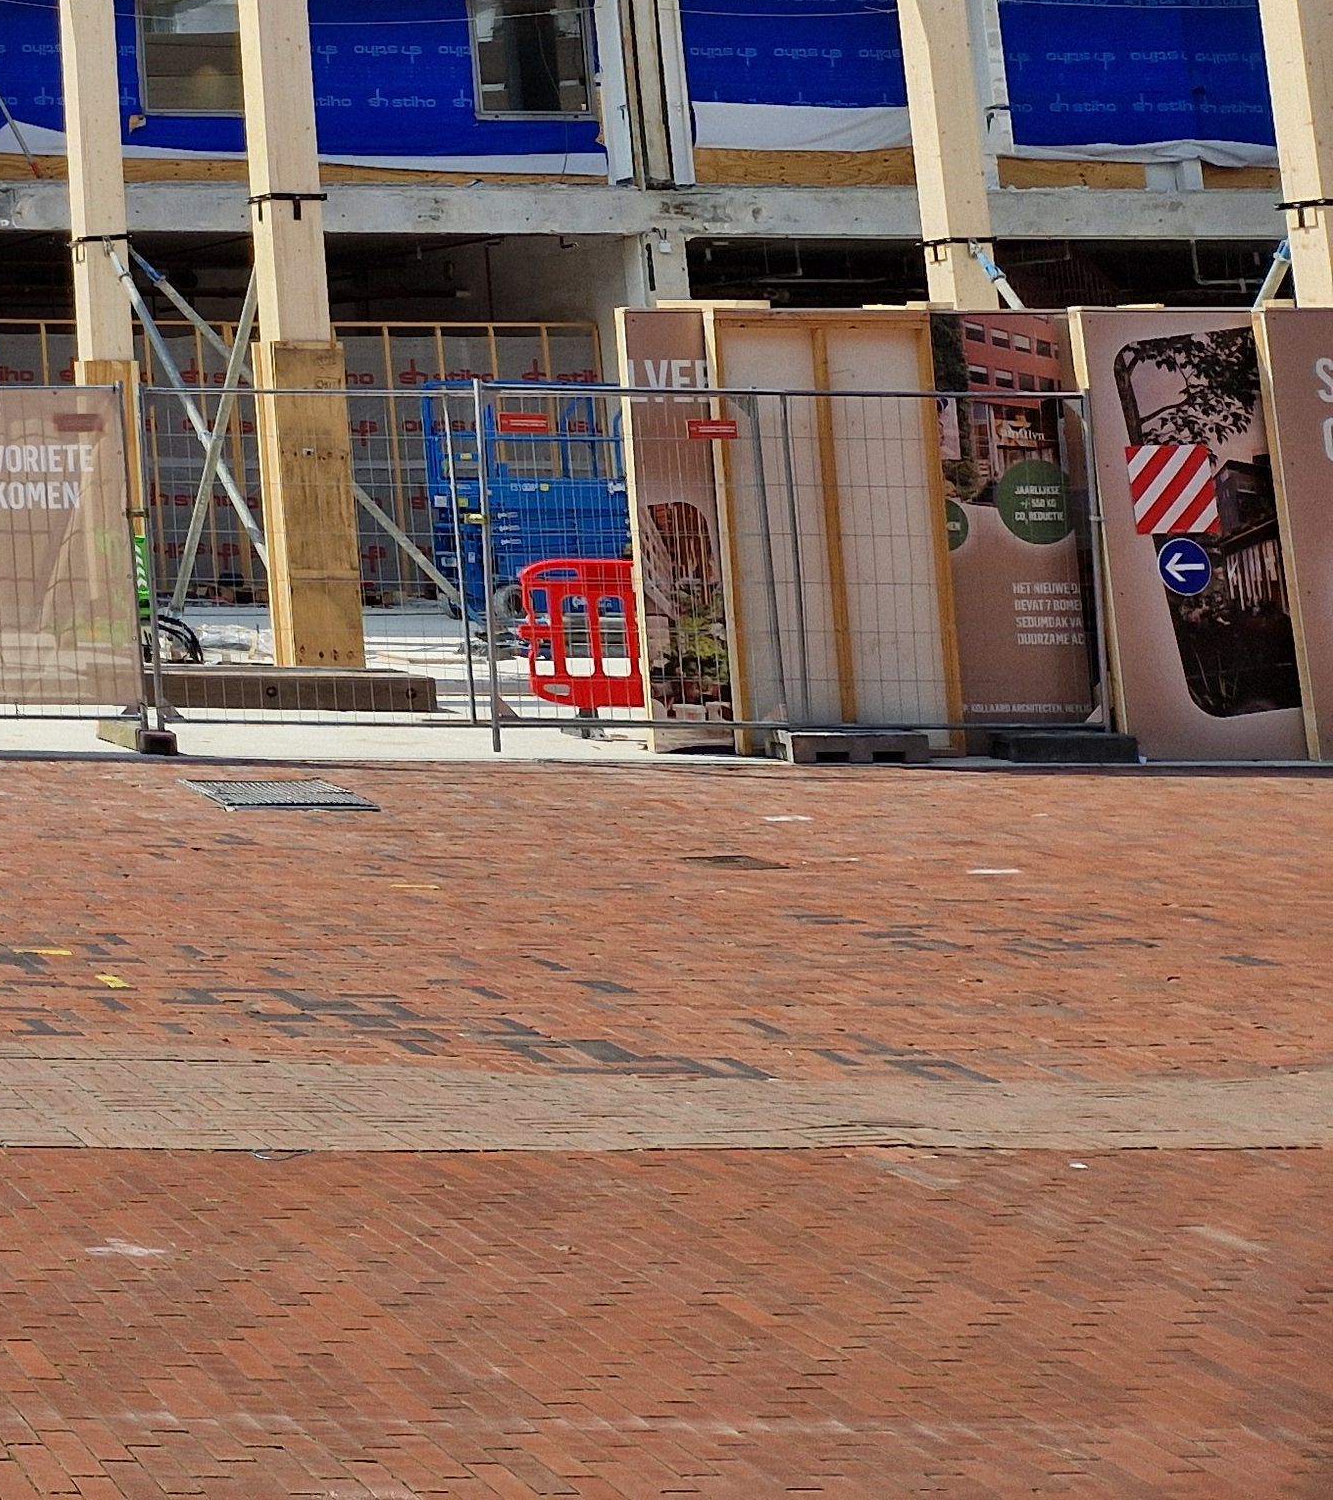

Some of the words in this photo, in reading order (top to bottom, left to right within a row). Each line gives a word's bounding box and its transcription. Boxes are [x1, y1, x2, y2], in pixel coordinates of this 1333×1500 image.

[1013, 582, 1031, 594] HET
[1032, 582, 1071, 594] NIEUWE
[1015, 616, 1069, 628] SEDUMDAK
[1017, 633, 1069, 645] DUURZAME
